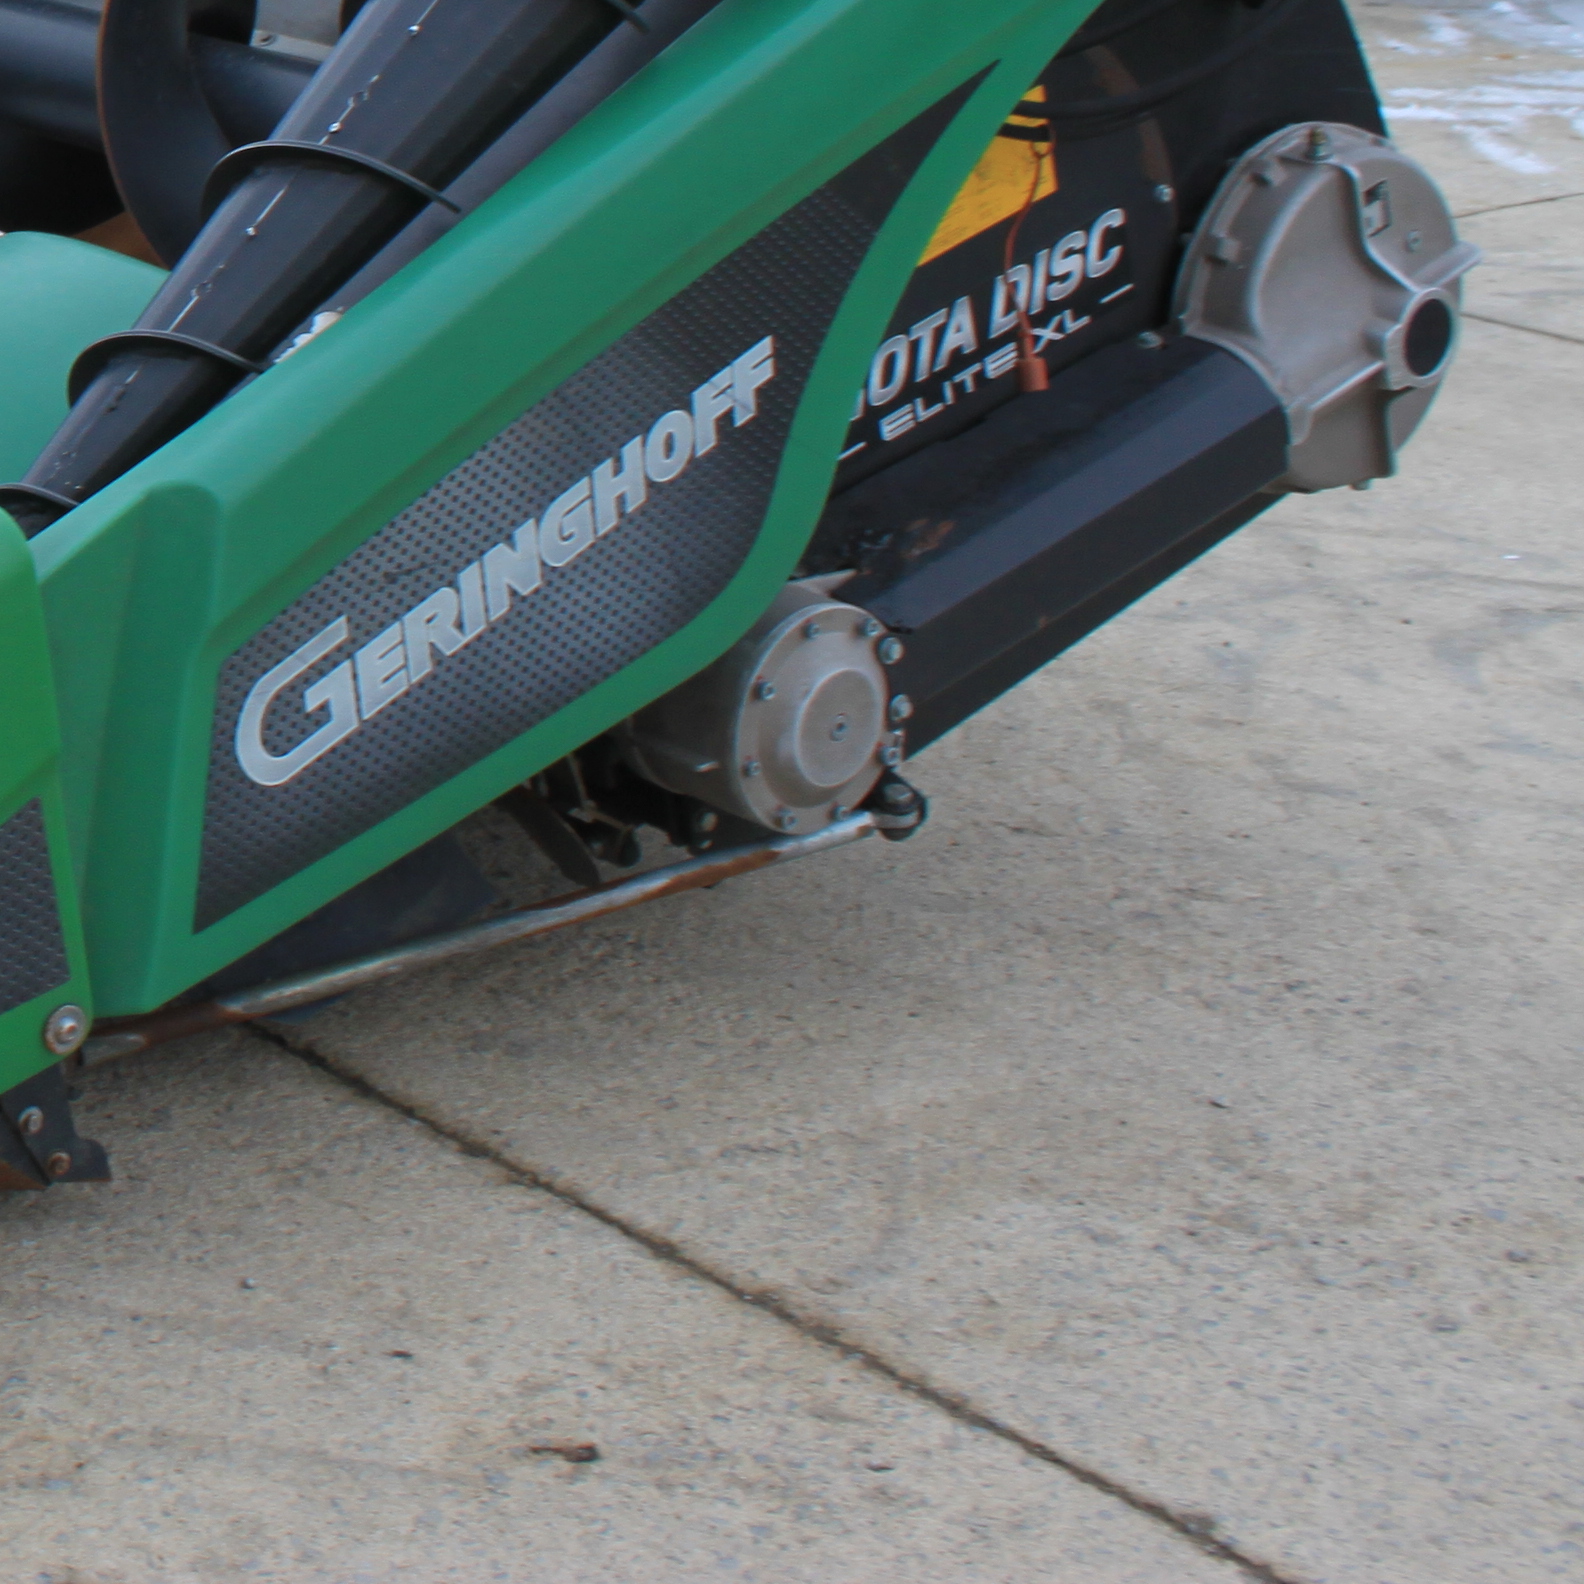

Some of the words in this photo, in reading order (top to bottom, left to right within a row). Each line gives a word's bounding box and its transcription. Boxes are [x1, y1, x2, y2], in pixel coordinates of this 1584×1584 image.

[850, 295, 978, 421] OTA
[988, 208, 1127, 339] DISC
[878, 341, 1019, 442] ELITE
[1030, 308, 1092, 355] XL
[235, 334, 775, 787] GERINGHOFF
